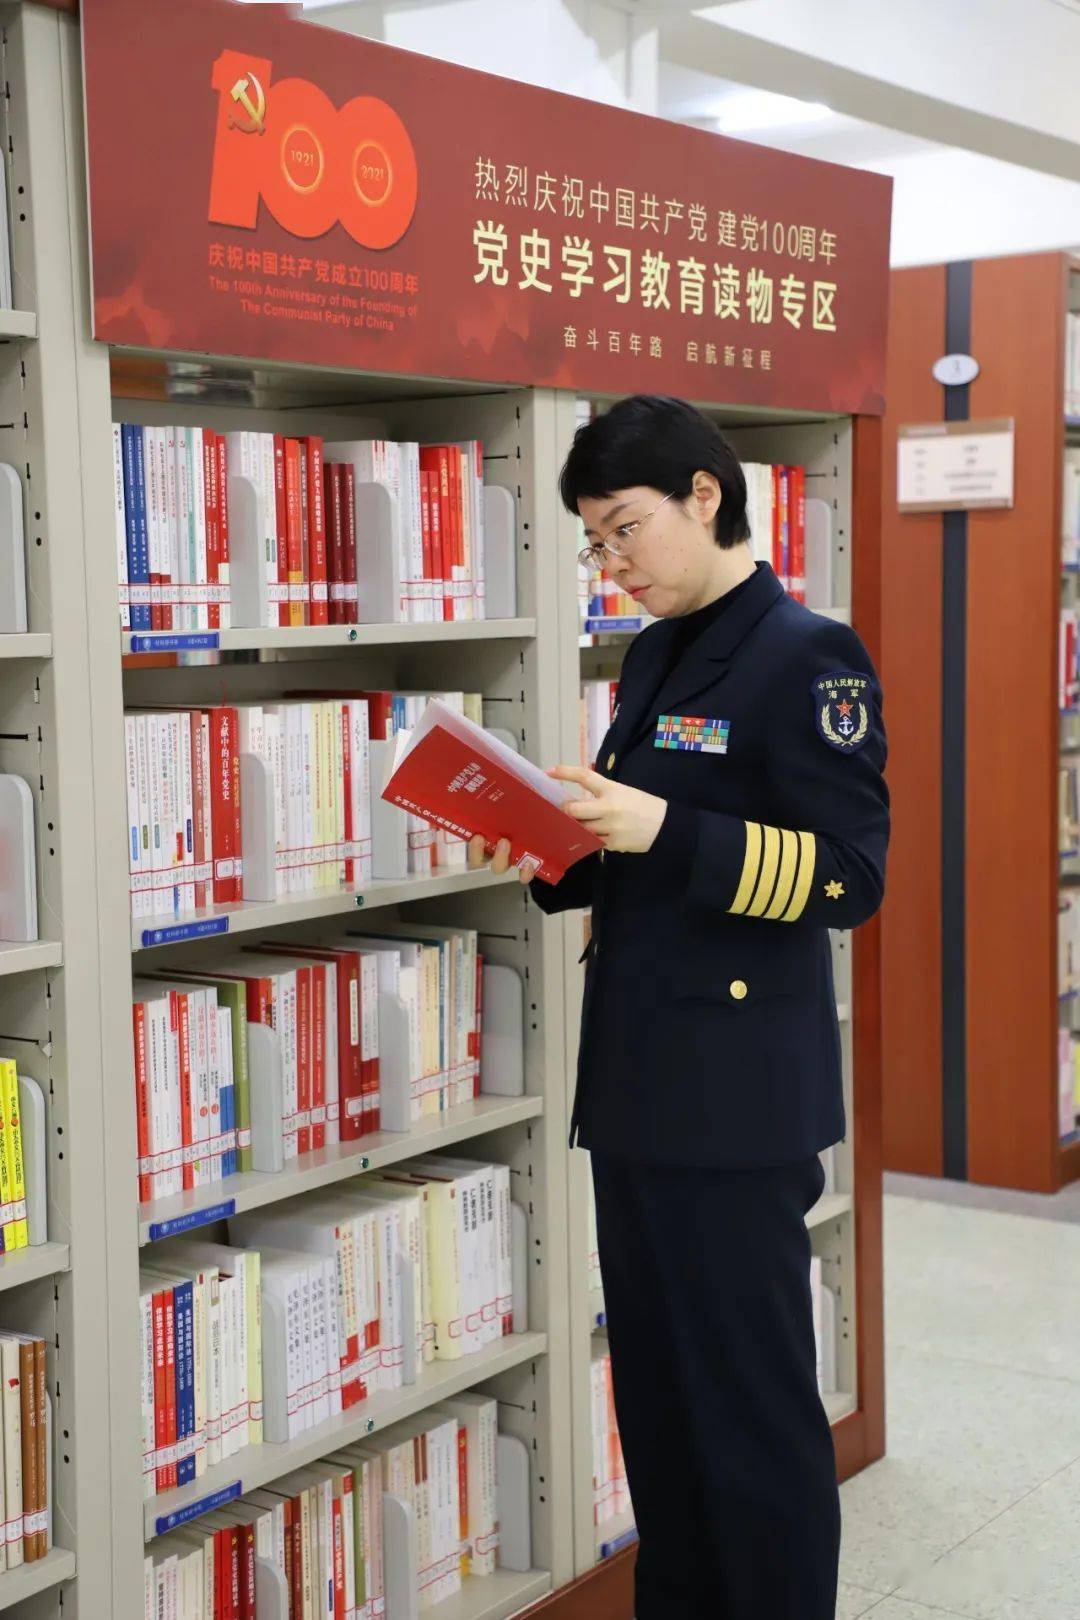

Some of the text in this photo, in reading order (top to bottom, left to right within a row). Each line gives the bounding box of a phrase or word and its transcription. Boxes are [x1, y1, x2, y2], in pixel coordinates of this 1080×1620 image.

[290, 149, 314, 168] 1921
[361, 164, 385, 182] 2021
[474, 156, 838, 266] 热烈庆祝中国共产党 建党100周年
[208, 244, 420, 296] 庆祝中国共产党成立100周年
[472, 219, 838, 333] 党史学习教育读物专区
[210, 276, 418, 317] The 100th Anniversary of the Founding of
[240, 300, 395, 331] The Communist Party of China
[564, 326, 772, 371] 奋斗百年路 启航新征程
[818, 678, 867, 691] 中国人民解放军
[219, 714, 230, 802] 文献中的百年党史
